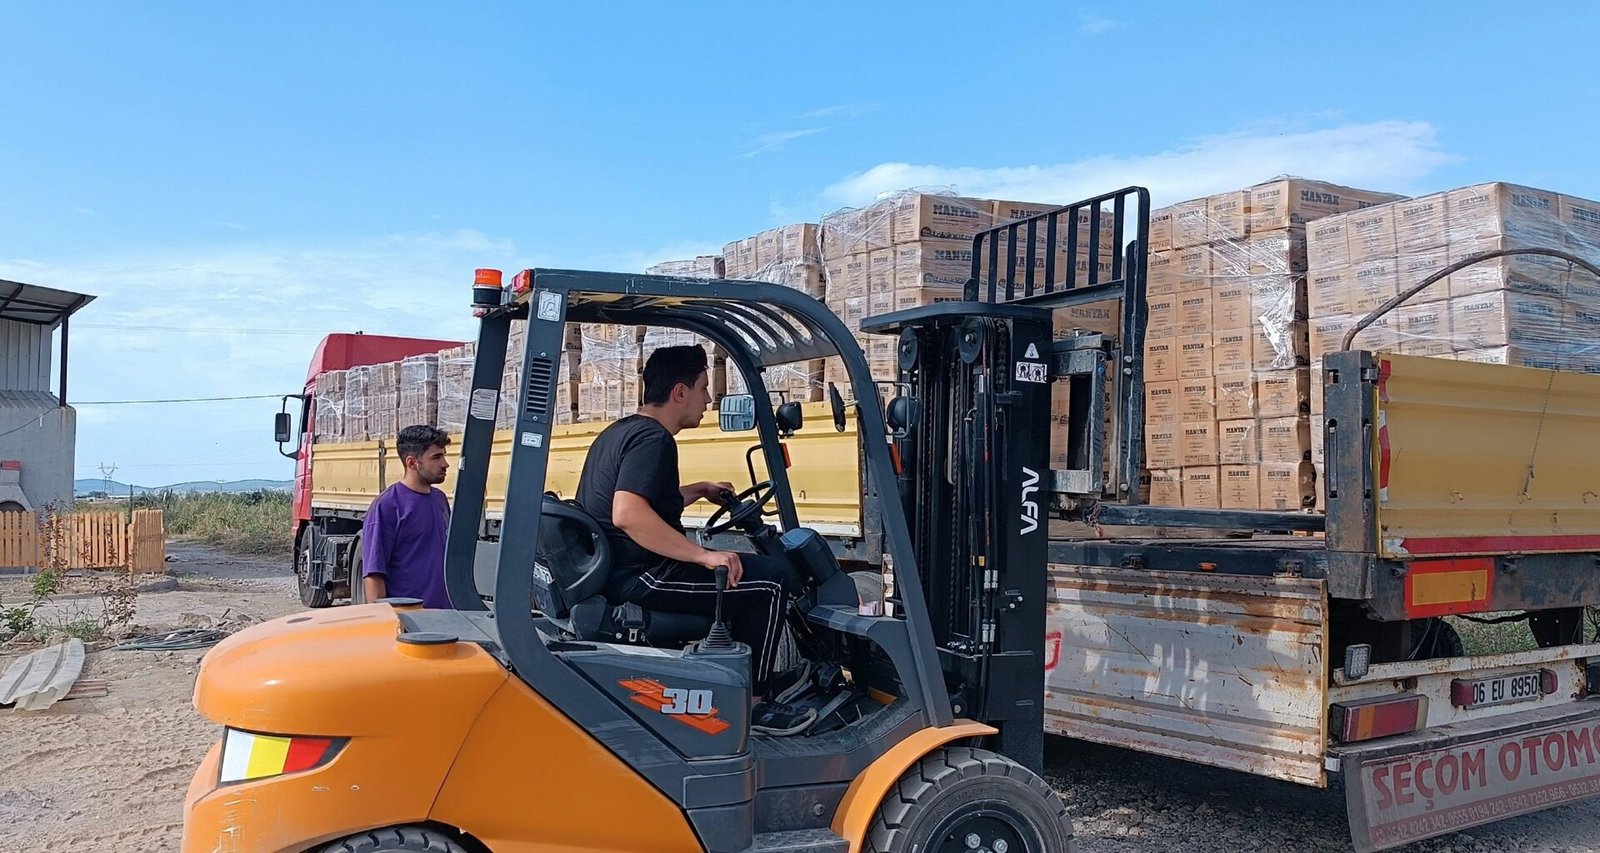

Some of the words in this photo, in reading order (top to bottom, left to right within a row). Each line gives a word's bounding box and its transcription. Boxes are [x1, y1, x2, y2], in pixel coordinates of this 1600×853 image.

[1020, 466, 1040, 536] ALFA
[661, 688, 713, 714] 30
[1472, 682, 1486, 705] 06
[1491, 679, 1505, 701] EU
[1511, 675, 1538, 698] 8950
[1372, 748, 1488, 811] SEÇOM
